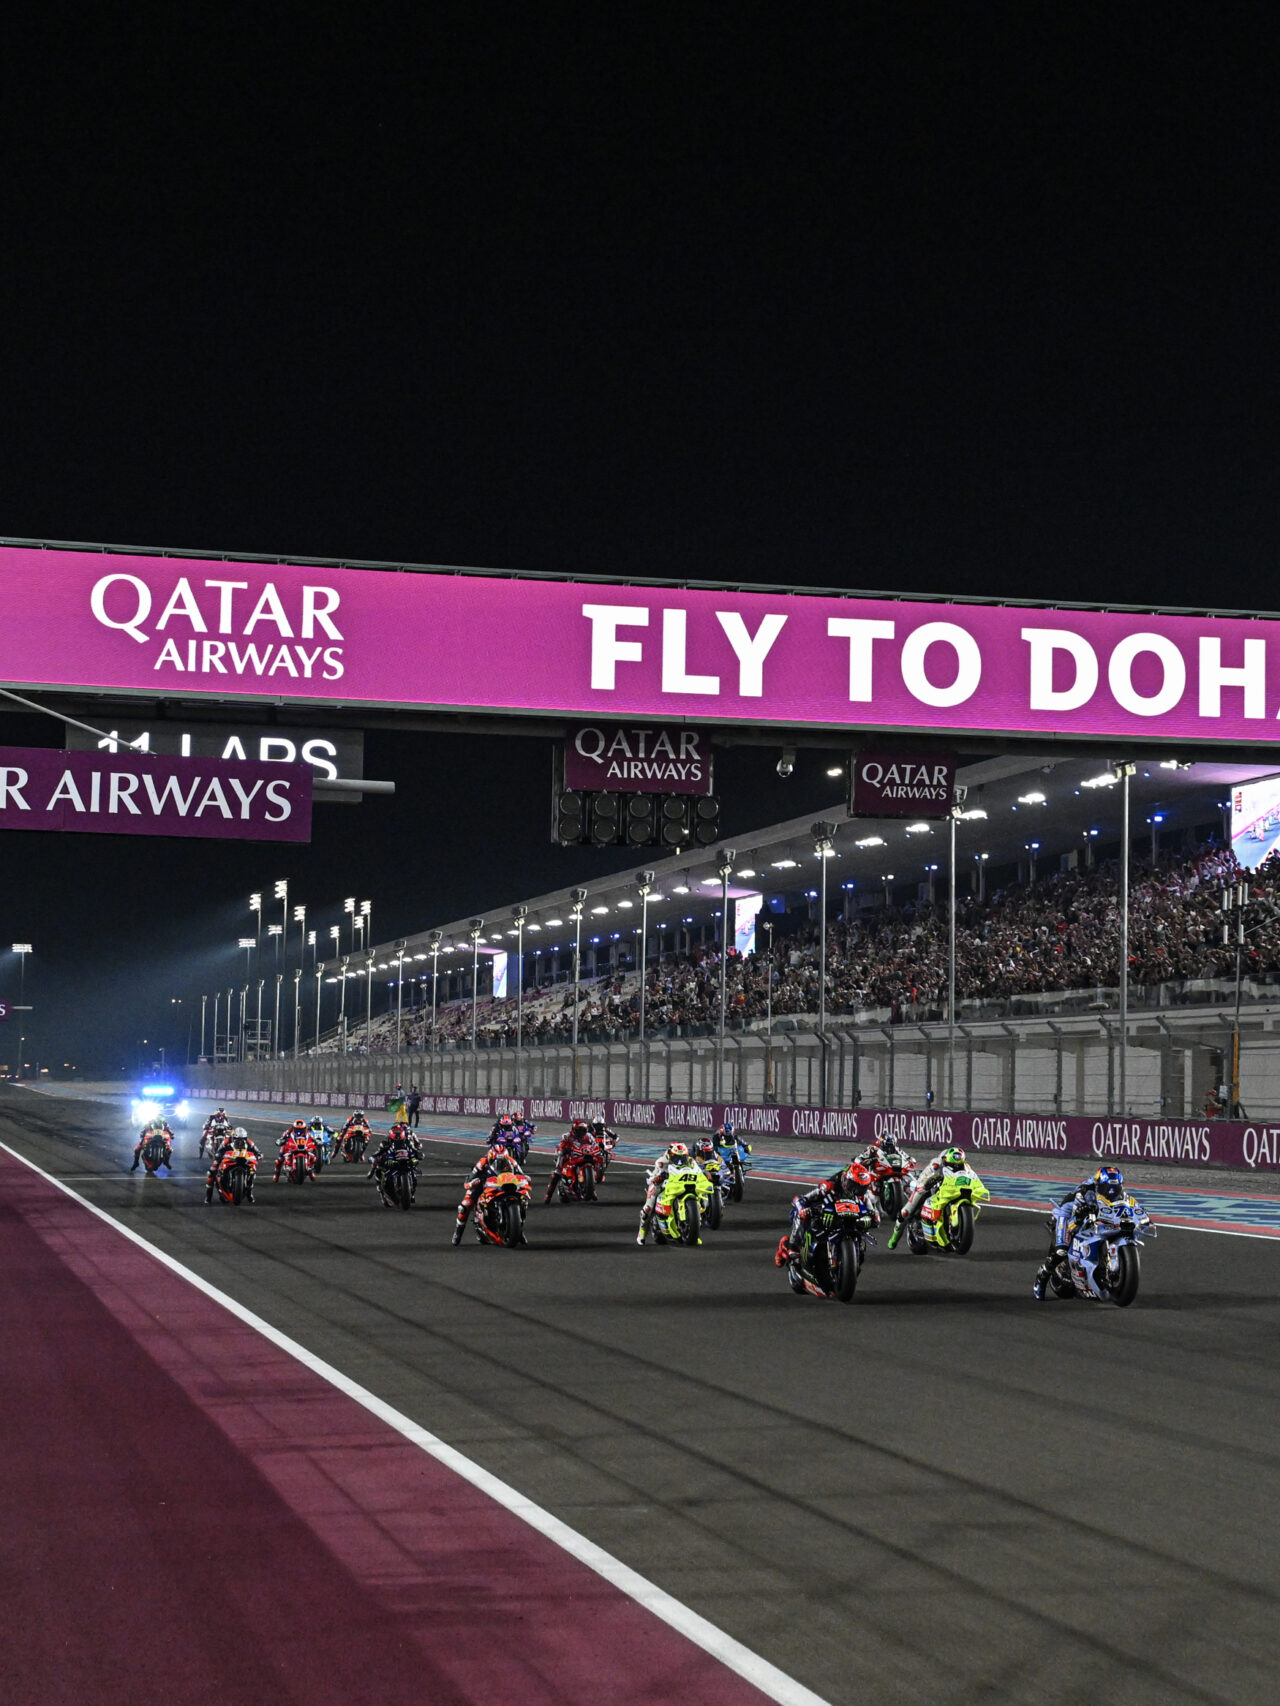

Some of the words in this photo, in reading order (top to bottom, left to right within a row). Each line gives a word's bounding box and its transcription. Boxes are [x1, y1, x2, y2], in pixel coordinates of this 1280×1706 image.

[90, 573, 345, 643] QATAR
[154, 638, 345, 681] AIRWAYS
[582, 603, 789, 698] FLY
[827, 617, 982, 708] TO
[575, 727, 702, 764] QATAR
[607, 761, 702, 781] AIRWAYS
[861, 763, 948, 786] QATAR
[46, 770, 292, 822] AIRWAYS
[881, 786, 948, 800] AIRWAYS
[569, 1101, 585, 1121] QATAR
[613, 1102, 631, 1123] QATAR
[632, 1104, 656, 1124] AIRWAYS
[664, 1104, 685, 1127] QATAR
[686, 1105, 713, 1128] AIRWAYS
[724, 1107, 748, 1130] QATAR
[749, 1109, 780, 1132] AIRWAYS
[792, 1110, 819, 1135] QATAR
[821, 1112, 858, 1138] AIRWAYS
[874, 1113, 907, 1140] QATAR
[909, 1115, 953, 1144] AIRWAYS
[972, 1116, 1011, 1149] QATAR
[1013, 1118, 1068, 1151] AIRWAYS
[1092, 1123, 1141, 1158] QATAR
[1144, 1125, 1211, 1162] AIRWAYS
[678, 1173, 698, 1182] 49
[955, 1175, 971, 1186] 21
